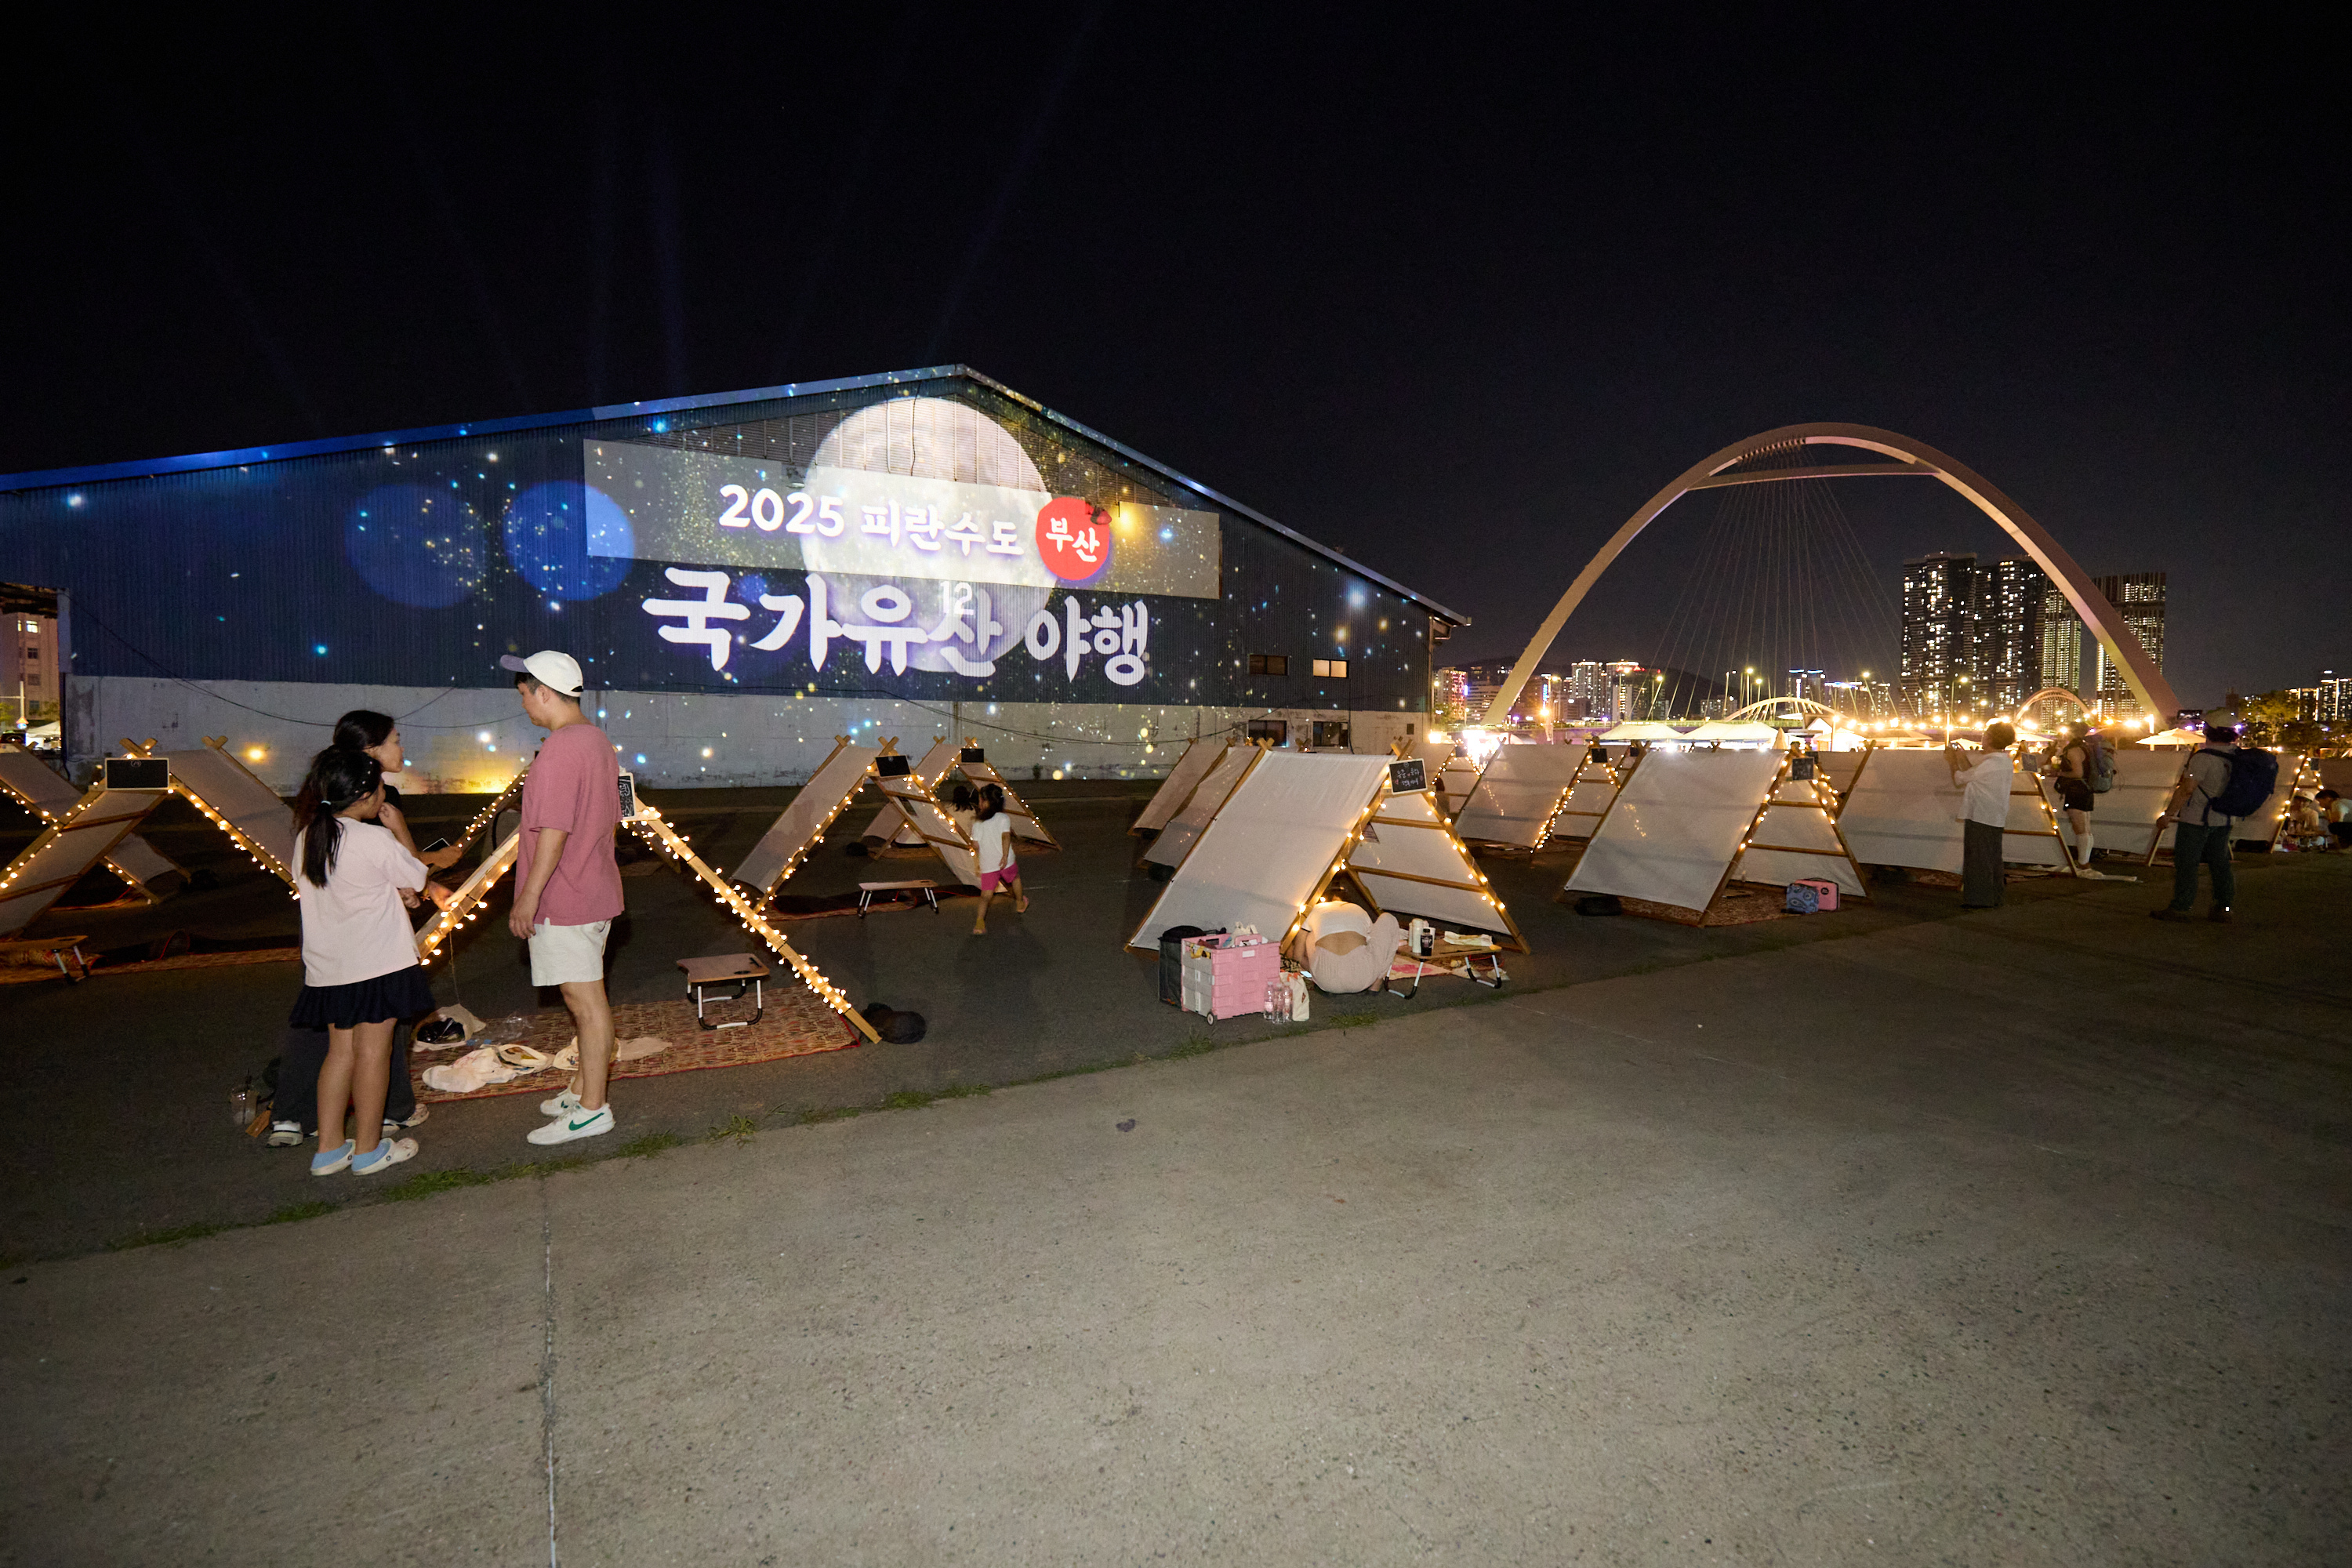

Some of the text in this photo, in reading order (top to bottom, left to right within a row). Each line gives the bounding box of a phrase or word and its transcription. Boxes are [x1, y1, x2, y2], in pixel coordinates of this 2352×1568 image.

[719, 484, 1101, 563] 2025 피란수도 부산
[641, 566, 1149, 686] 국가유산 야행
[940, 580, 975, 615] 12
